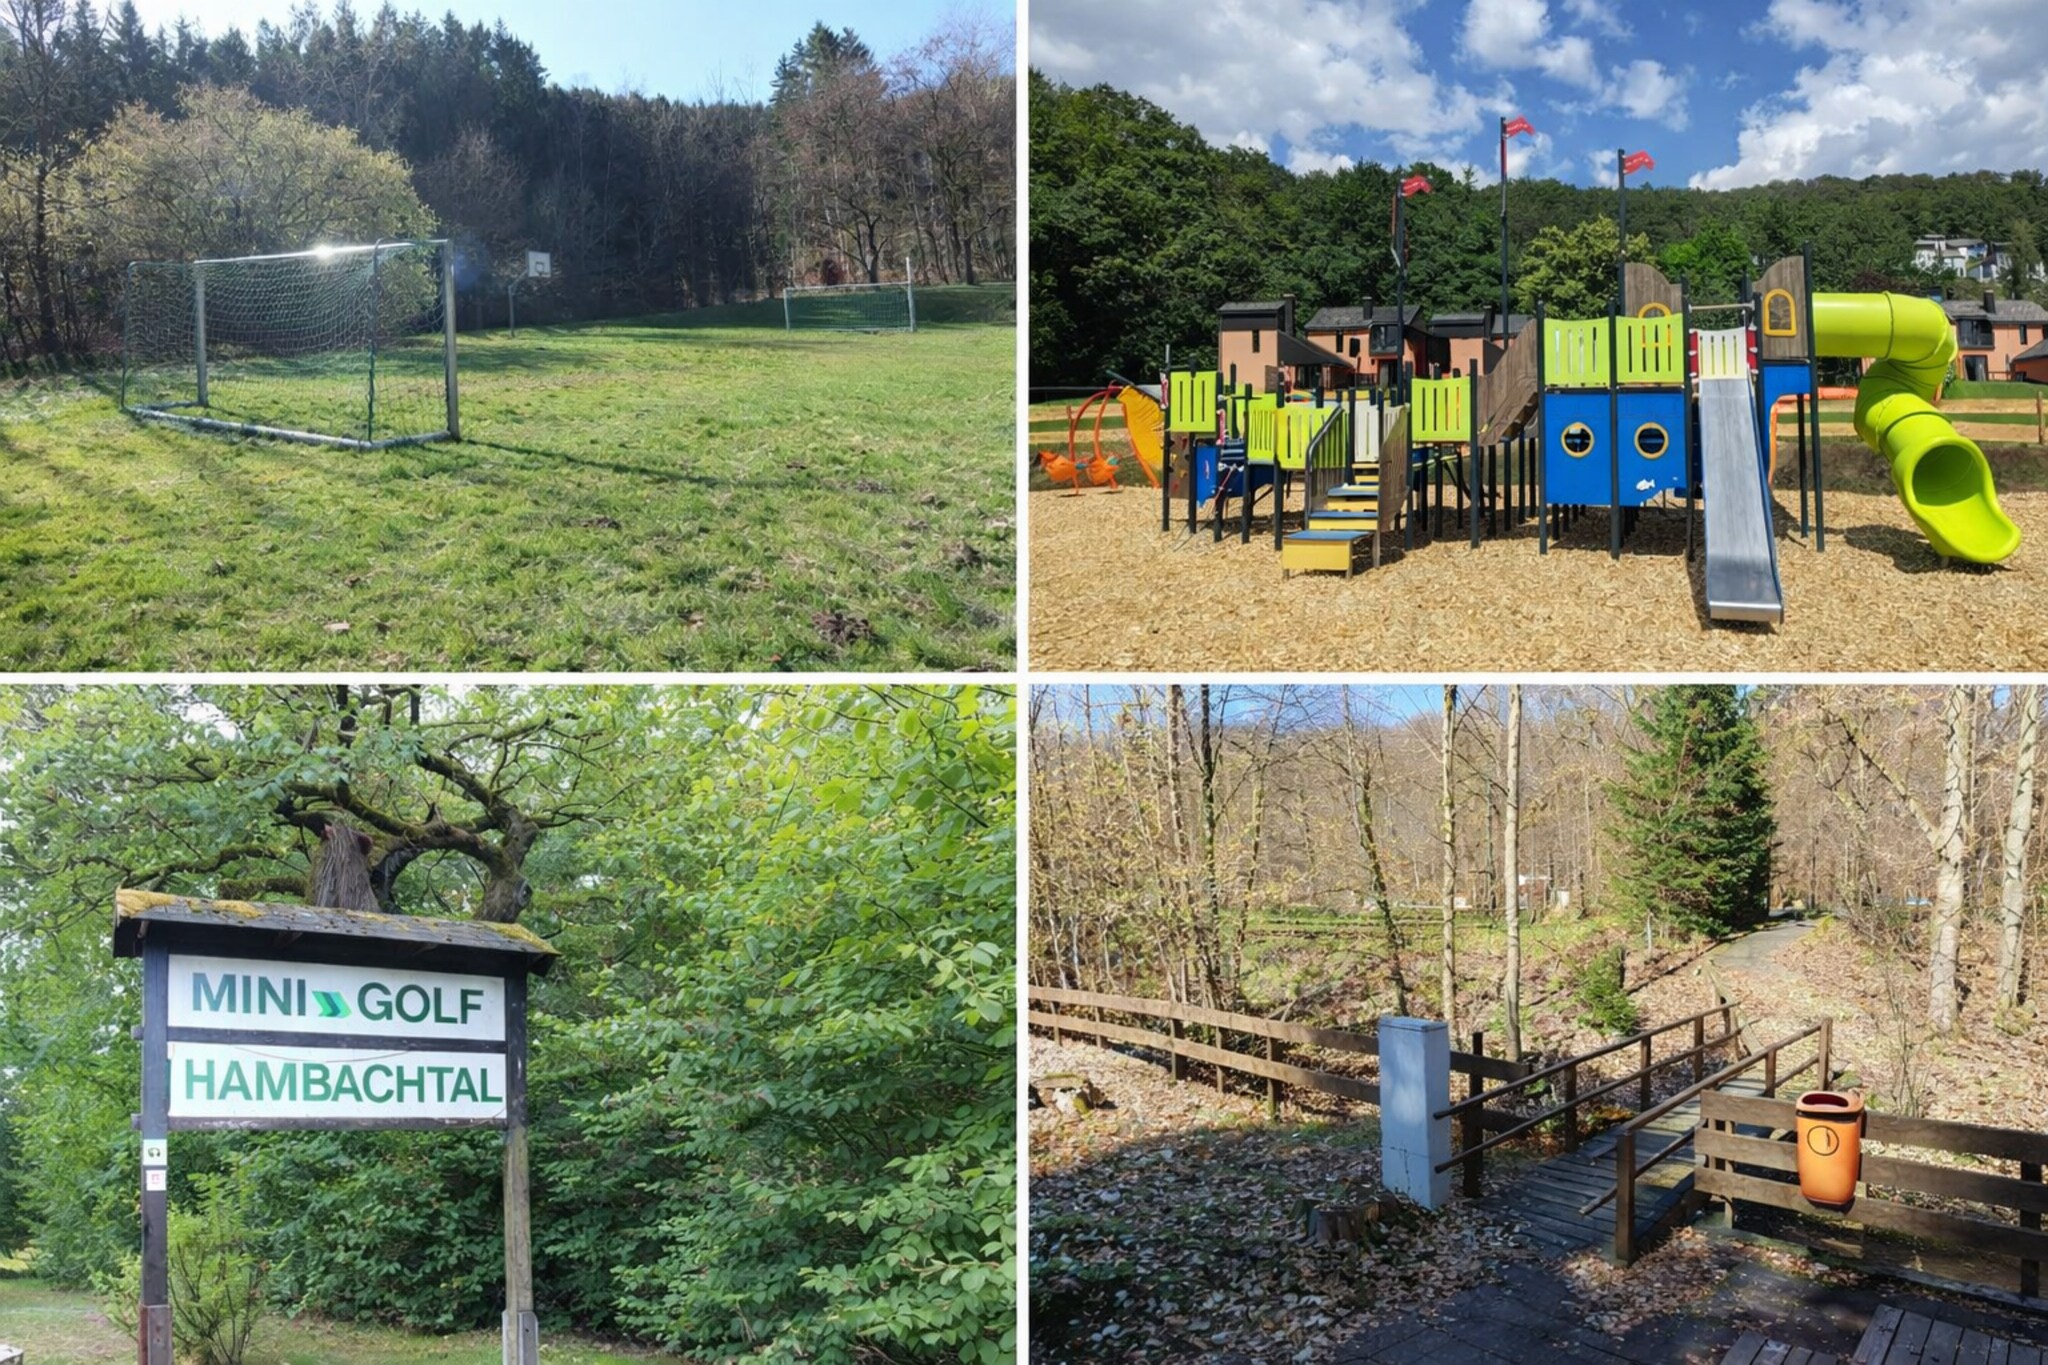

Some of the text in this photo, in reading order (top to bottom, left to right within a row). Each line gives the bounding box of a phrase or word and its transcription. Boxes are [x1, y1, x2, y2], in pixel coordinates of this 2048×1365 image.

[192, 972, 484, 1024] MINI GOLF
[185, 1058, 503, 1103] HAMBACHTAL
